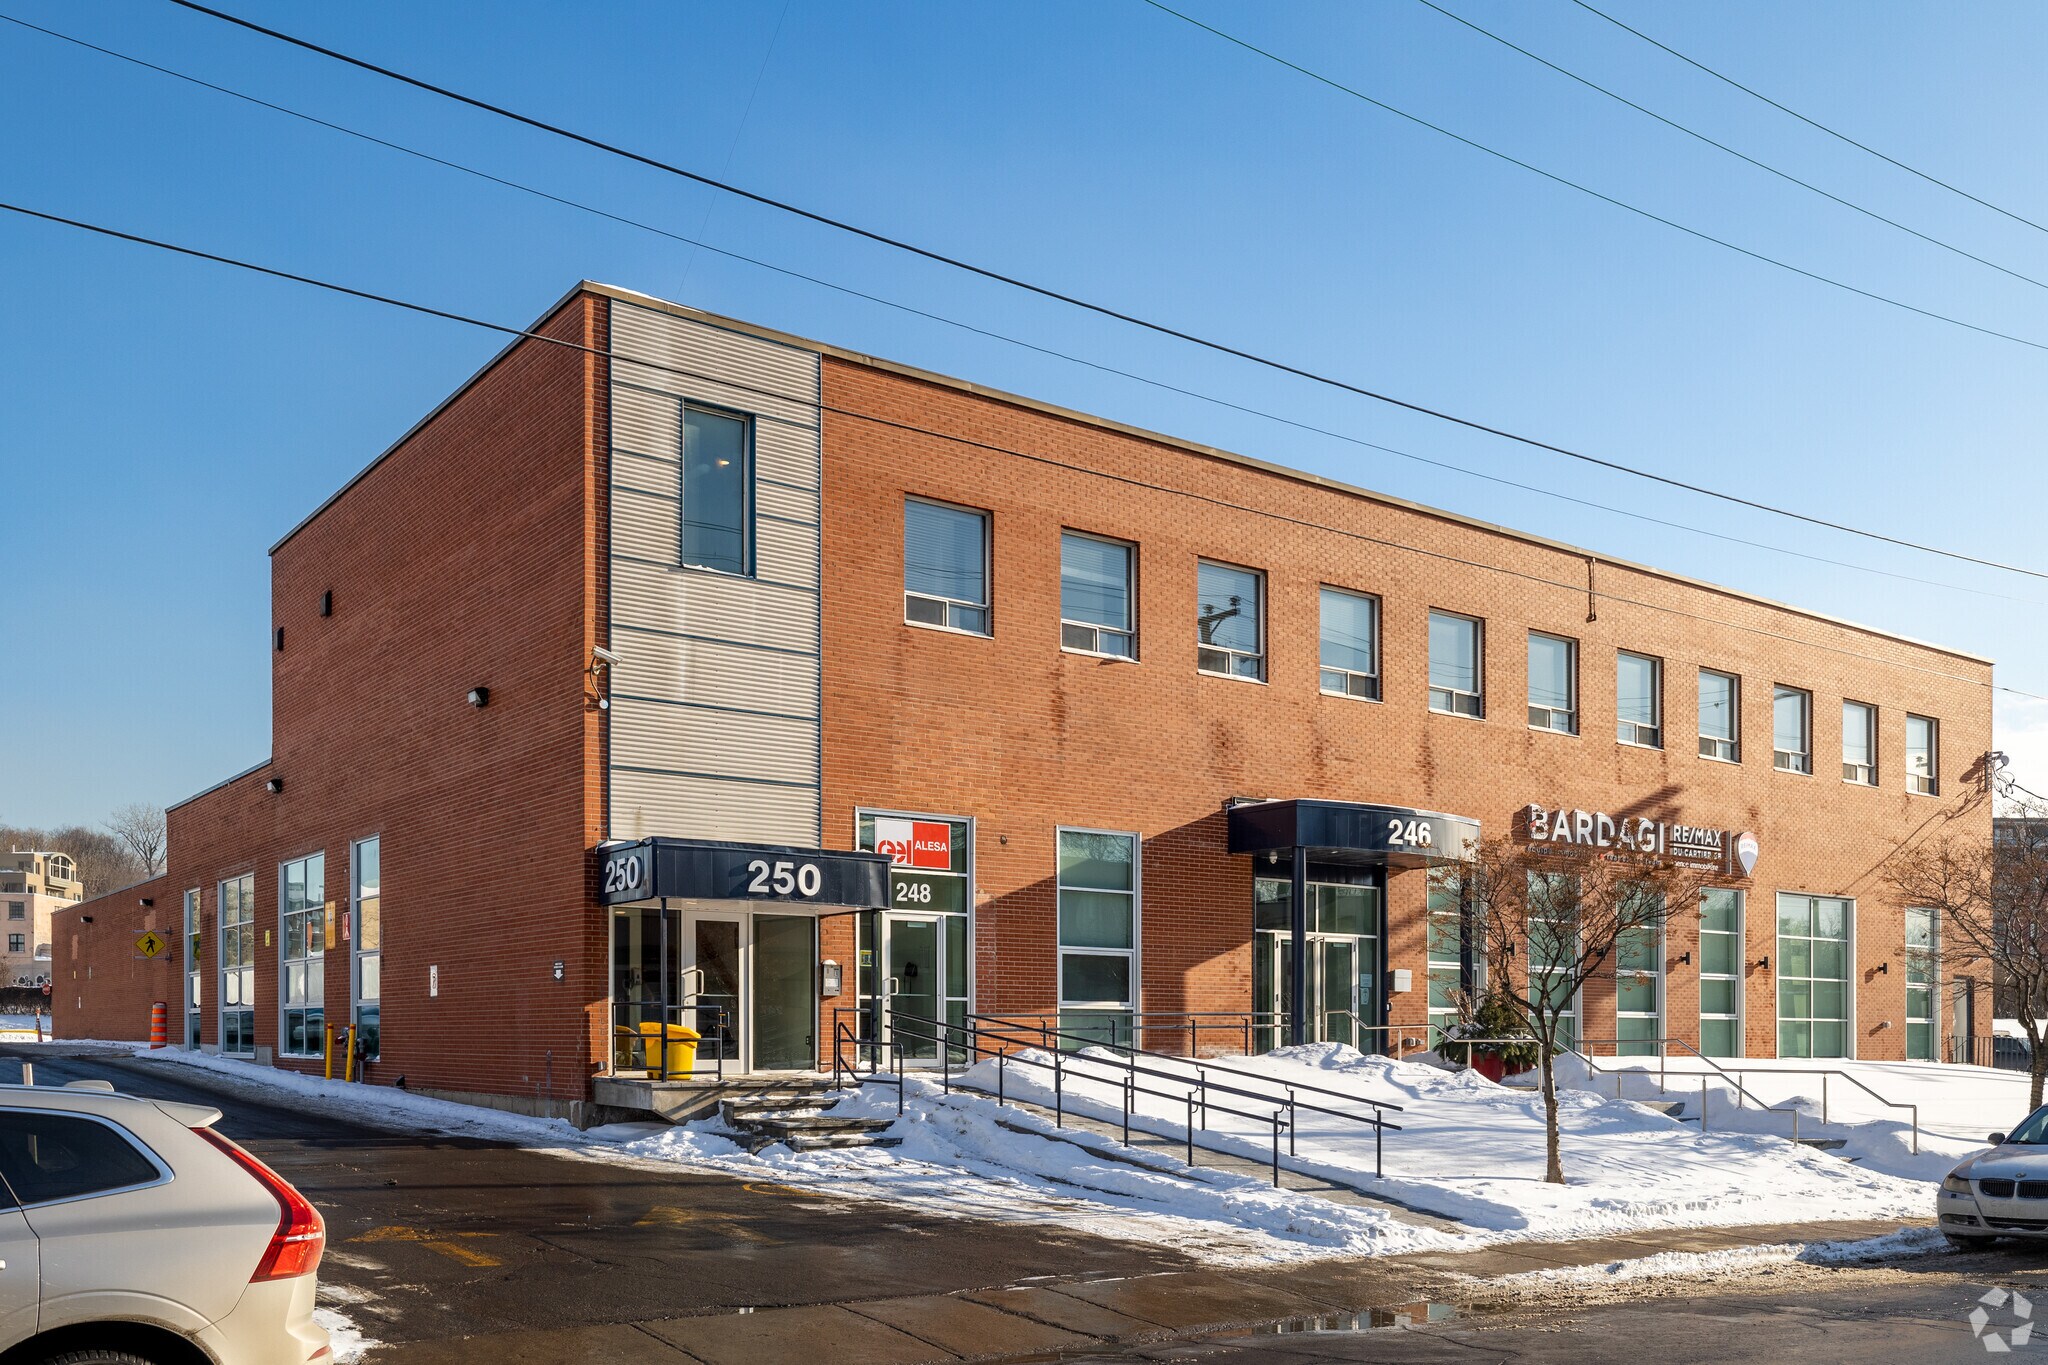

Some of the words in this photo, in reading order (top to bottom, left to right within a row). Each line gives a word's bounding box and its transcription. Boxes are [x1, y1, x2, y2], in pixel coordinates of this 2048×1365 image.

[1388, 819, 1431, 848] 246
[1530, 804, 1664, 854] BARDAGI
[1673, 824, 1721, 847] RE/MAX
[914, 840, 947, 852] ALESA
[1673, 848, 1683, 857] DU
[1685, 849, 1712, 859] CARTIER
[604, 855, 641, 893] 250
[747, 860, 821, 896] 250
[896, 882, 931, 903] 248
